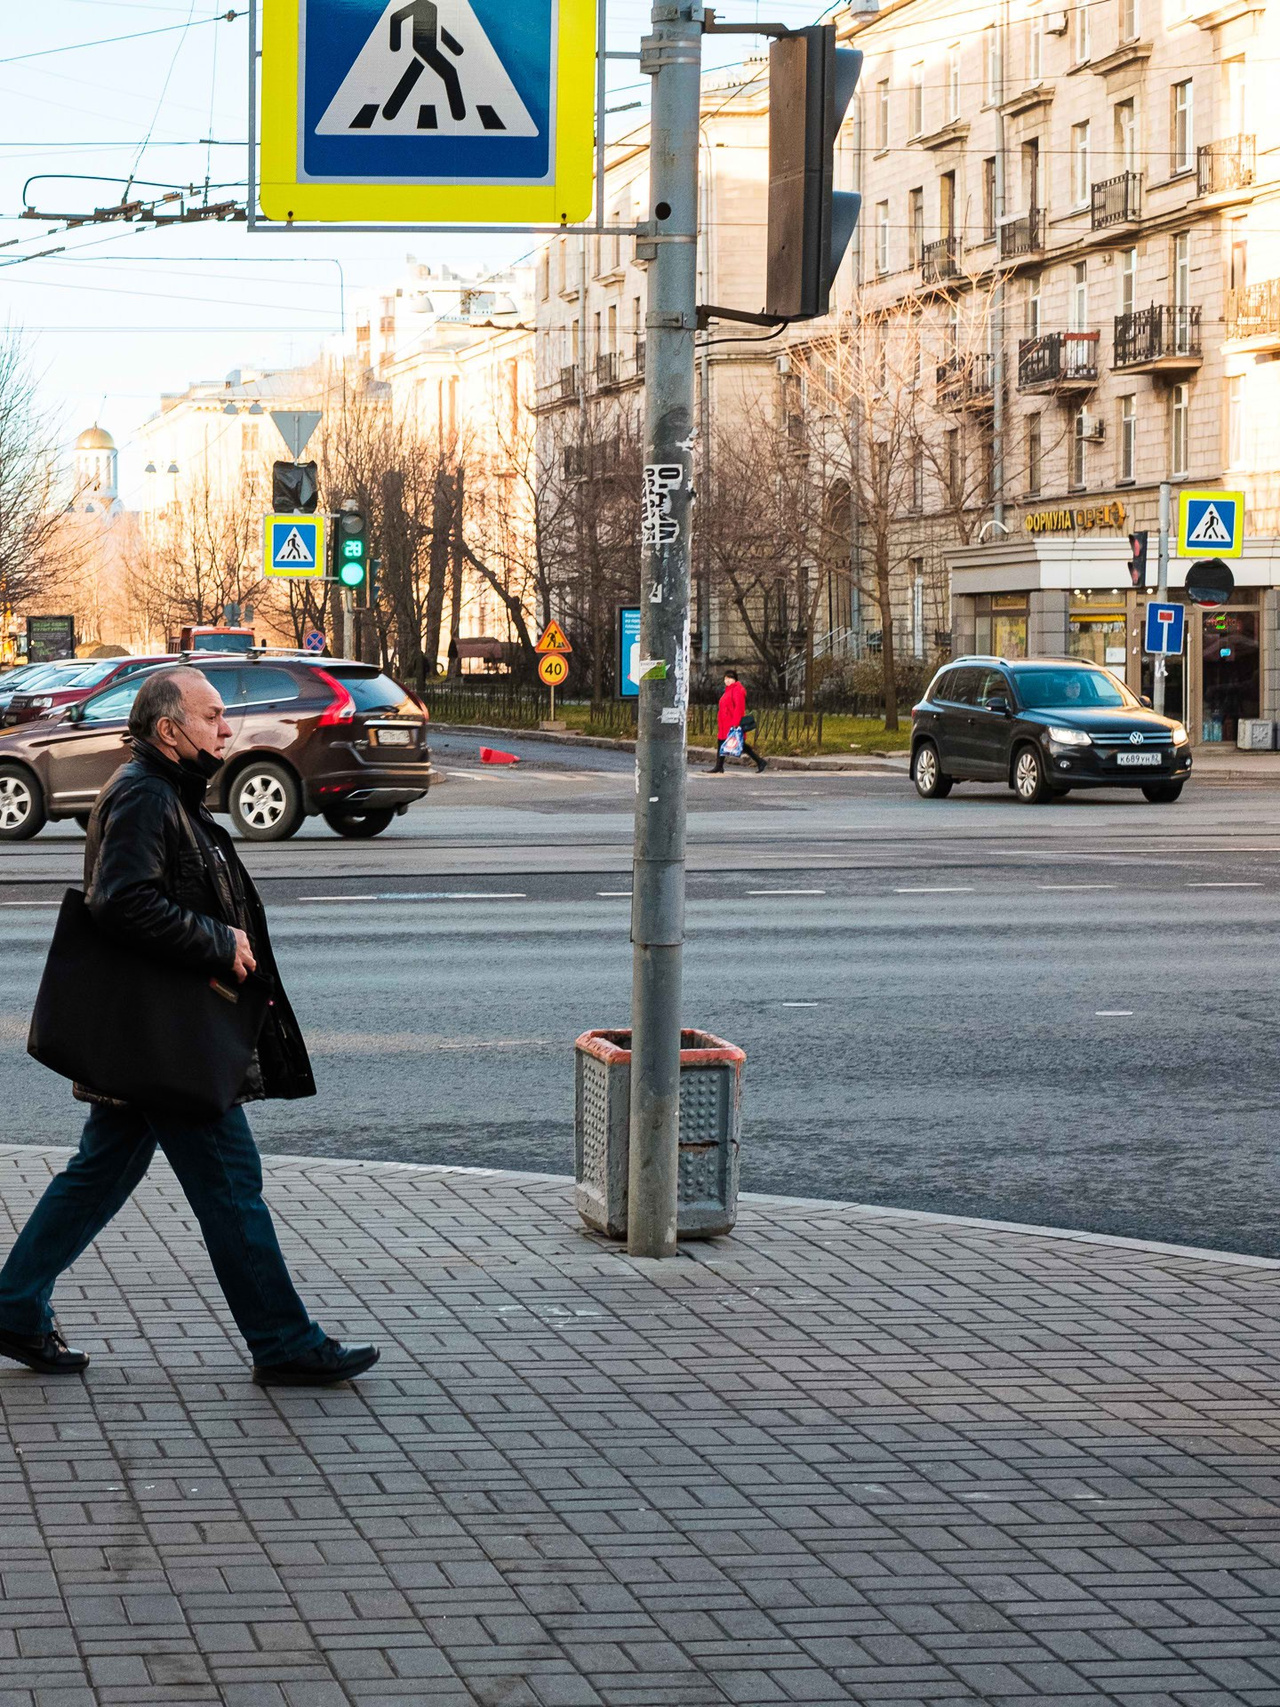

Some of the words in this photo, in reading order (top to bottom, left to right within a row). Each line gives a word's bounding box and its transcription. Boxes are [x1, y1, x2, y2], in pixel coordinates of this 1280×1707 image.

[1025, 510, 1072, 532] ФОРМУЛА
[345, 541, 363, 557] 28
[545, 663, 562, 675] 40
